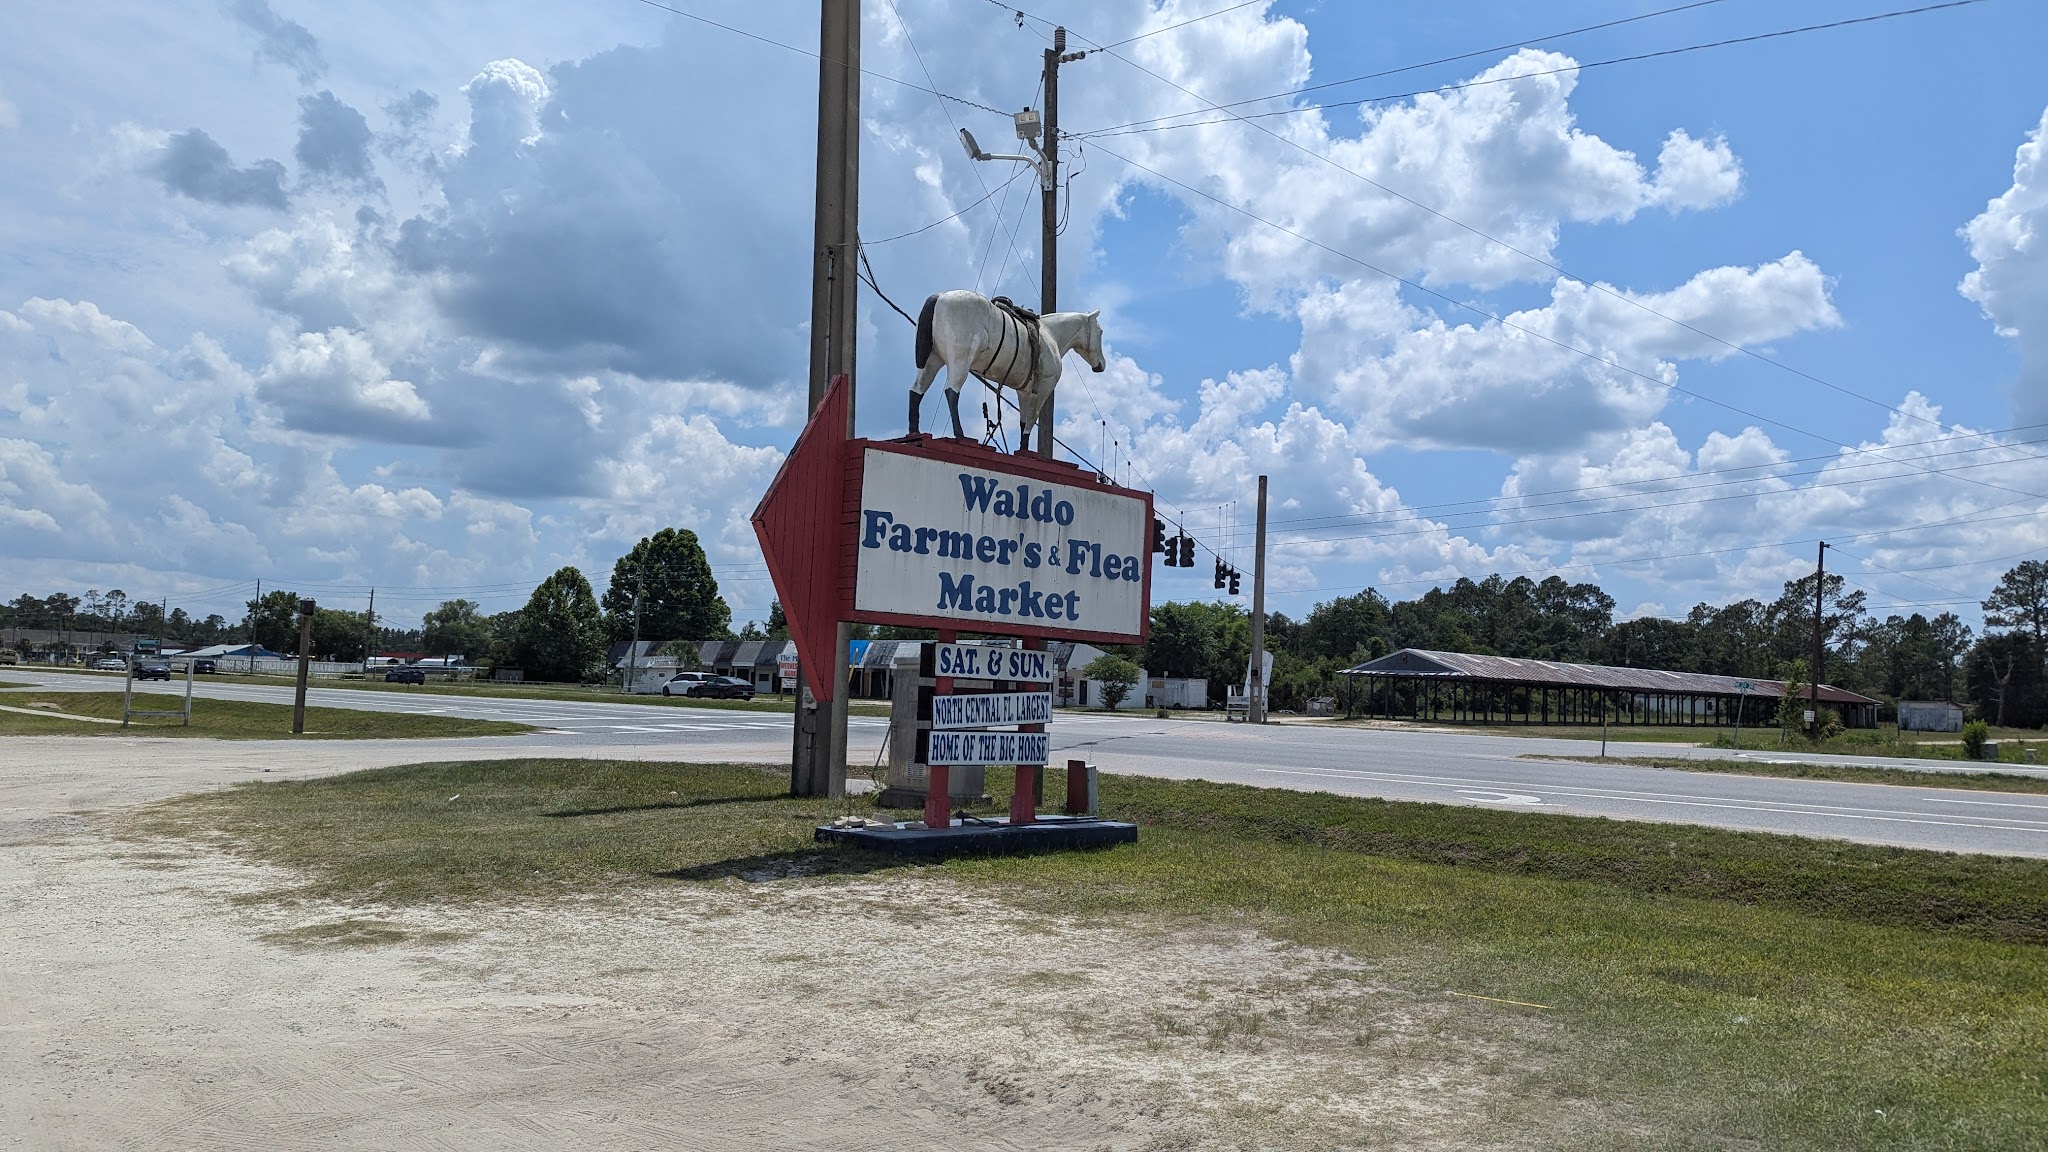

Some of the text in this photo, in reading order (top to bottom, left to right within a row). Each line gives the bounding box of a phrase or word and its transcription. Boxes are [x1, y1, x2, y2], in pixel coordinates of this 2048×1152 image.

[959, 474, 1074, 525] Waldo
[862, 510, 1139, 582] Farmer's & Flea
[937, 572, 1080, 620] Market
[940, 647, 1049, 678] SAT. & SUN.
[935, 695, 1049, 724] NORTH CENTRAL FL. LARGEST
[931, 735, 1047, 760] HOME OF THE BIG HORSE
